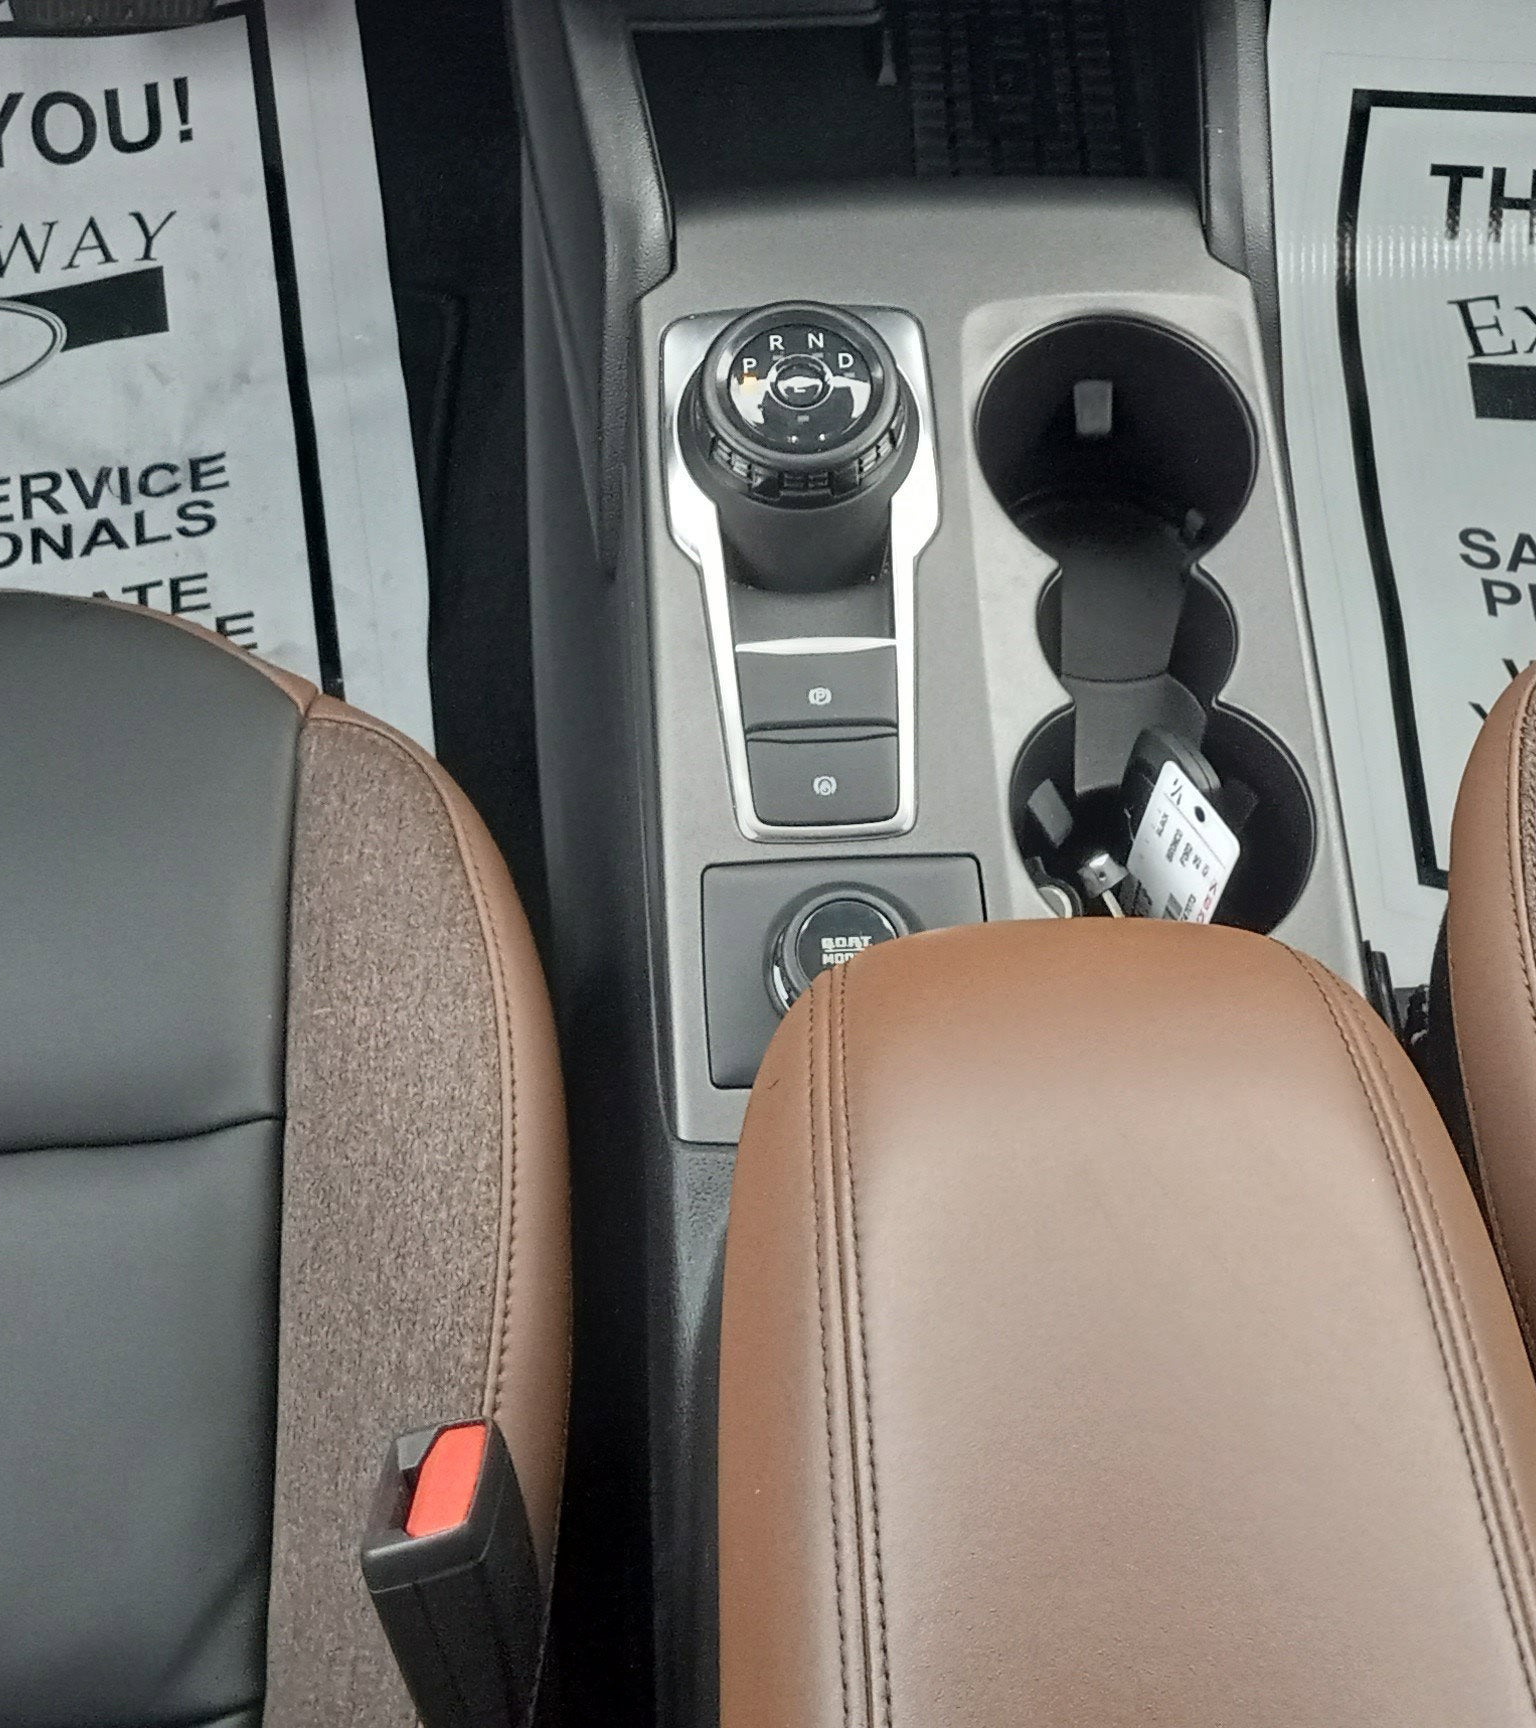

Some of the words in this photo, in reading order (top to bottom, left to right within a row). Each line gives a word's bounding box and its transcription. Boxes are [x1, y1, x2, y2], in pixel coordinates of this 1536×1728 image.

[769, 334, 785, 351] R
[807, 332, 825, 349] N
[743, 358, 757, 374] P
[838, 353, 854, 369] D
